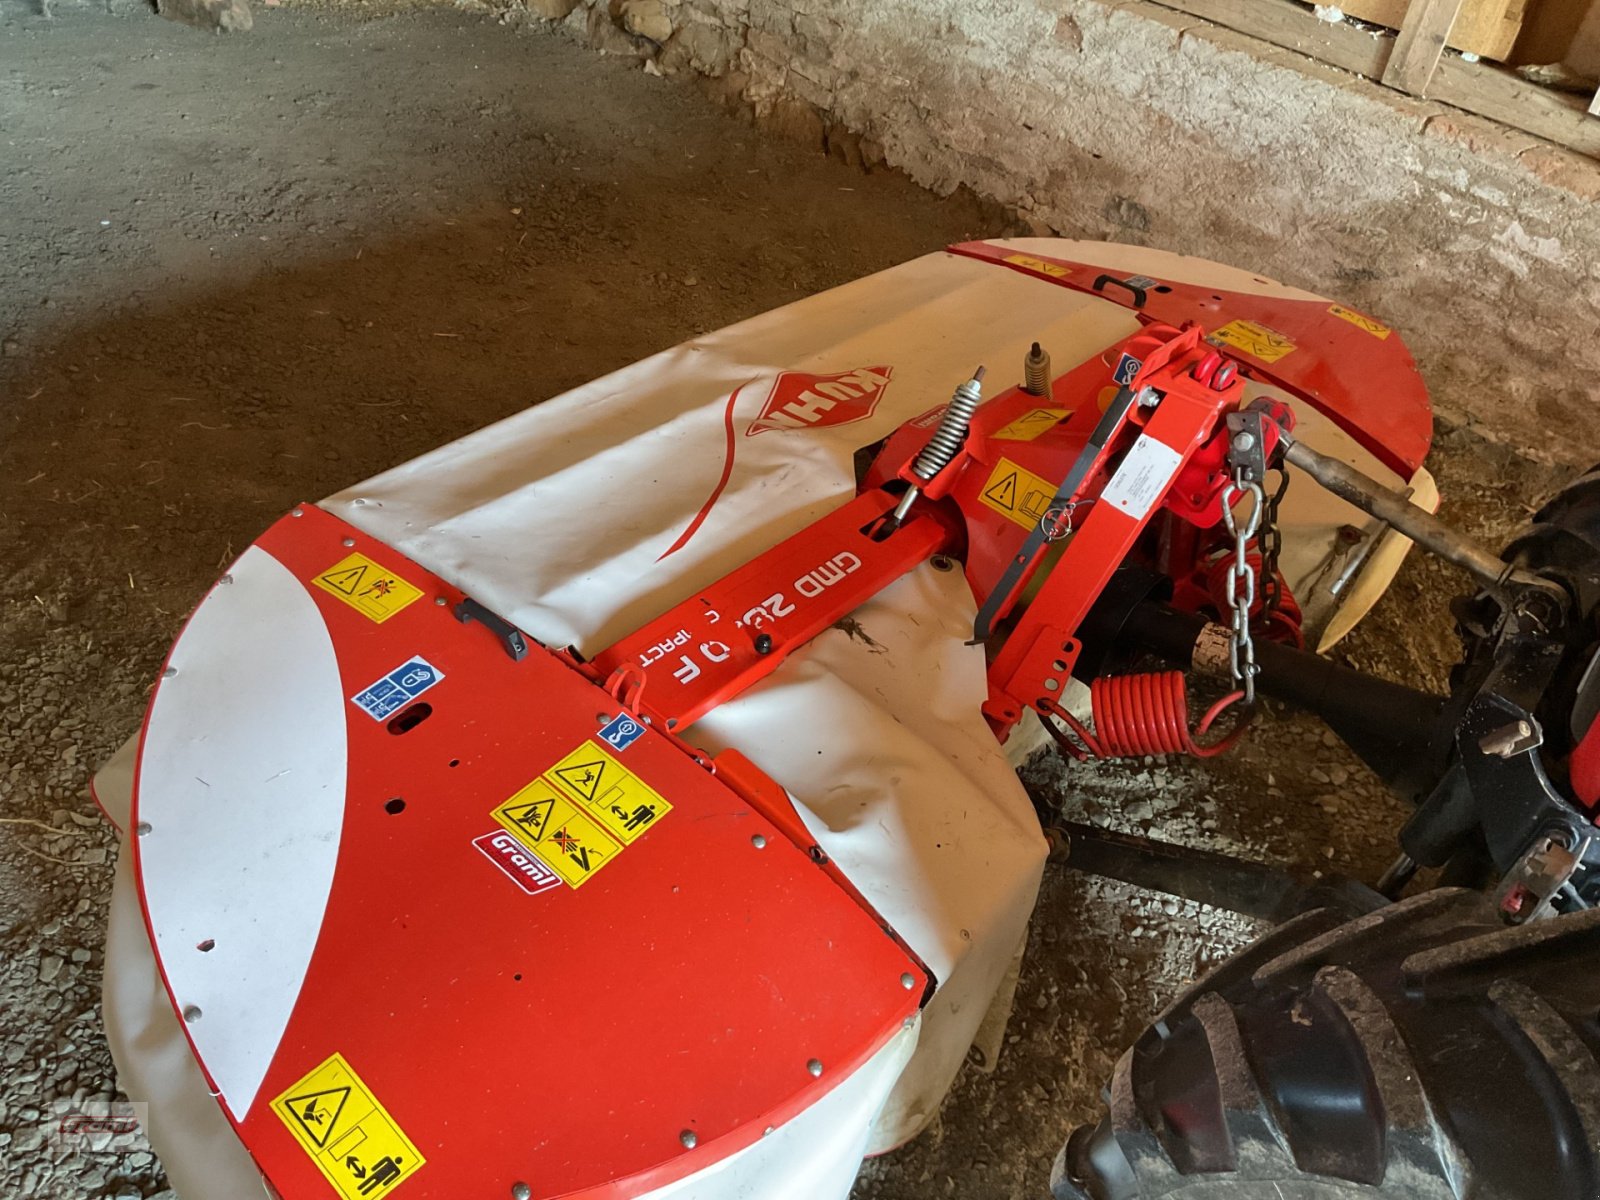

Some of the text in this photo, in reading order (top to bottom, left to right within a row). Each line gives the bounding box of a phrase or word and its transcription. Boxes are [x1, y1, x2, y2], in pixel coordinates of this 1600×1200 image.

[754, 368, 892, 430] KUHN
[793, 551, 862, 598] GMD
[672, 654, 701, 685] F
[491, 834, 557, 886] Graml
